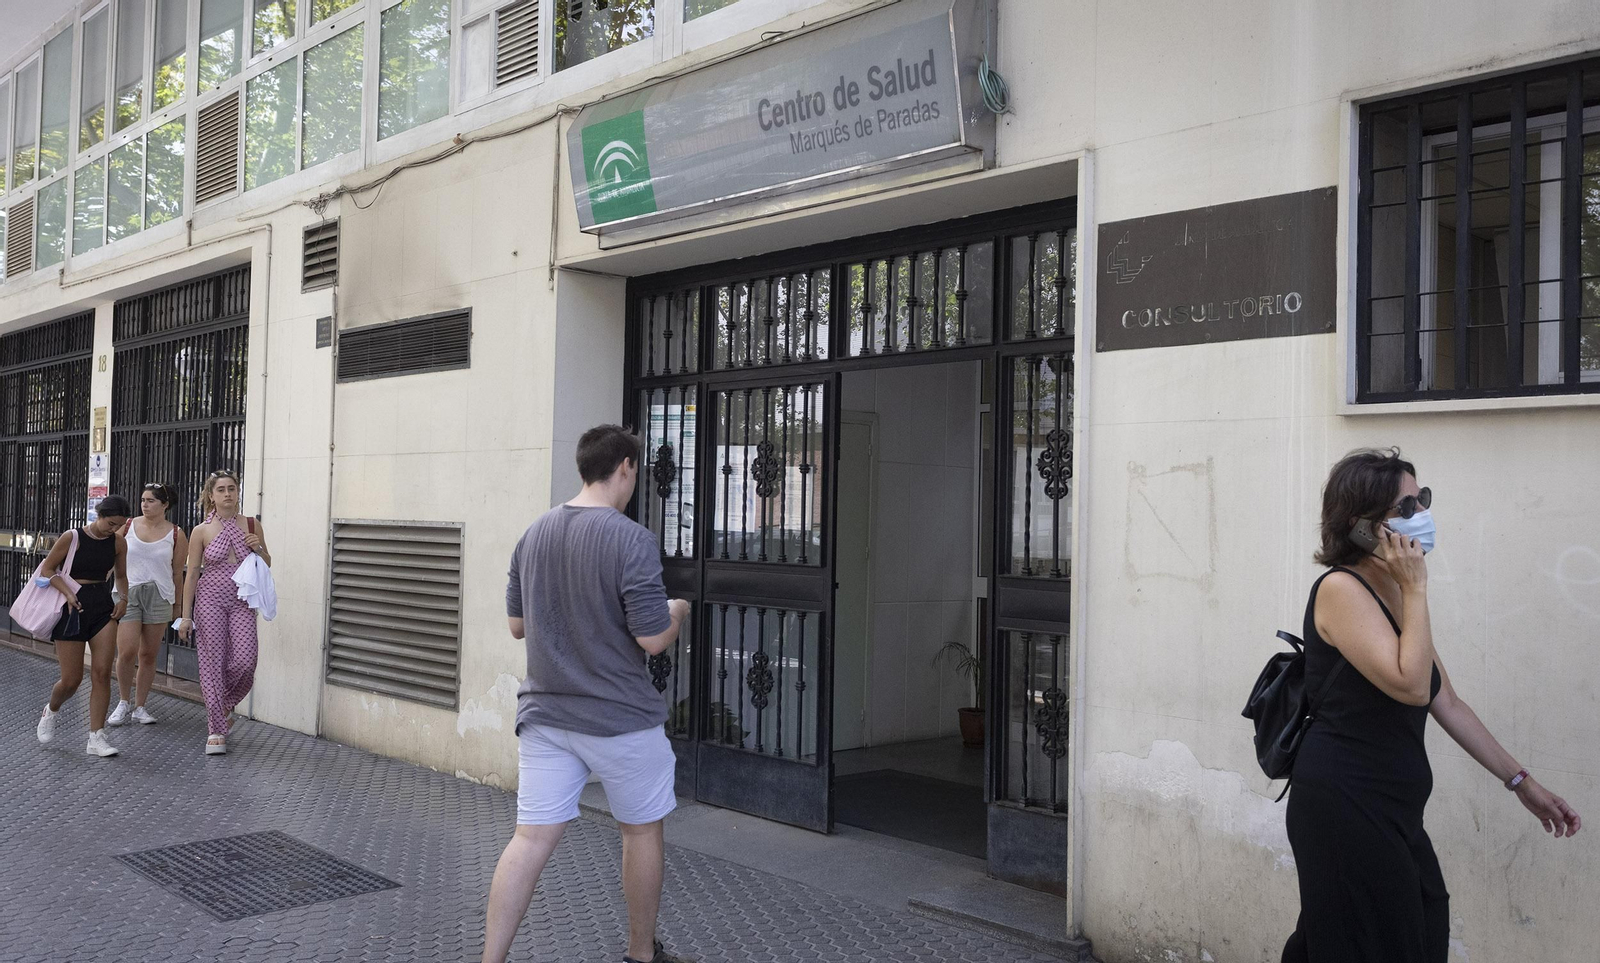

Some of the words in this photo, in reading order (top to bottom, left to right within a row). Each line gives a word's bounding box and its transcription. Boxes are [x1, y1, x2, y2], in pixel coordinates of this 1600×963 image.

[758, 90, 826, 131] Centro
[833, 76, 860, 111] de
[867, 49, 937, 101] Salud
[790, 120, 850, 154] Marqués
[855, 115, 873, 138] de
[877, 99, 940, 133] Paradas
[1121, 291, 1302, 329] CONSULTORIO
[98, 354, 107, 373] 18
